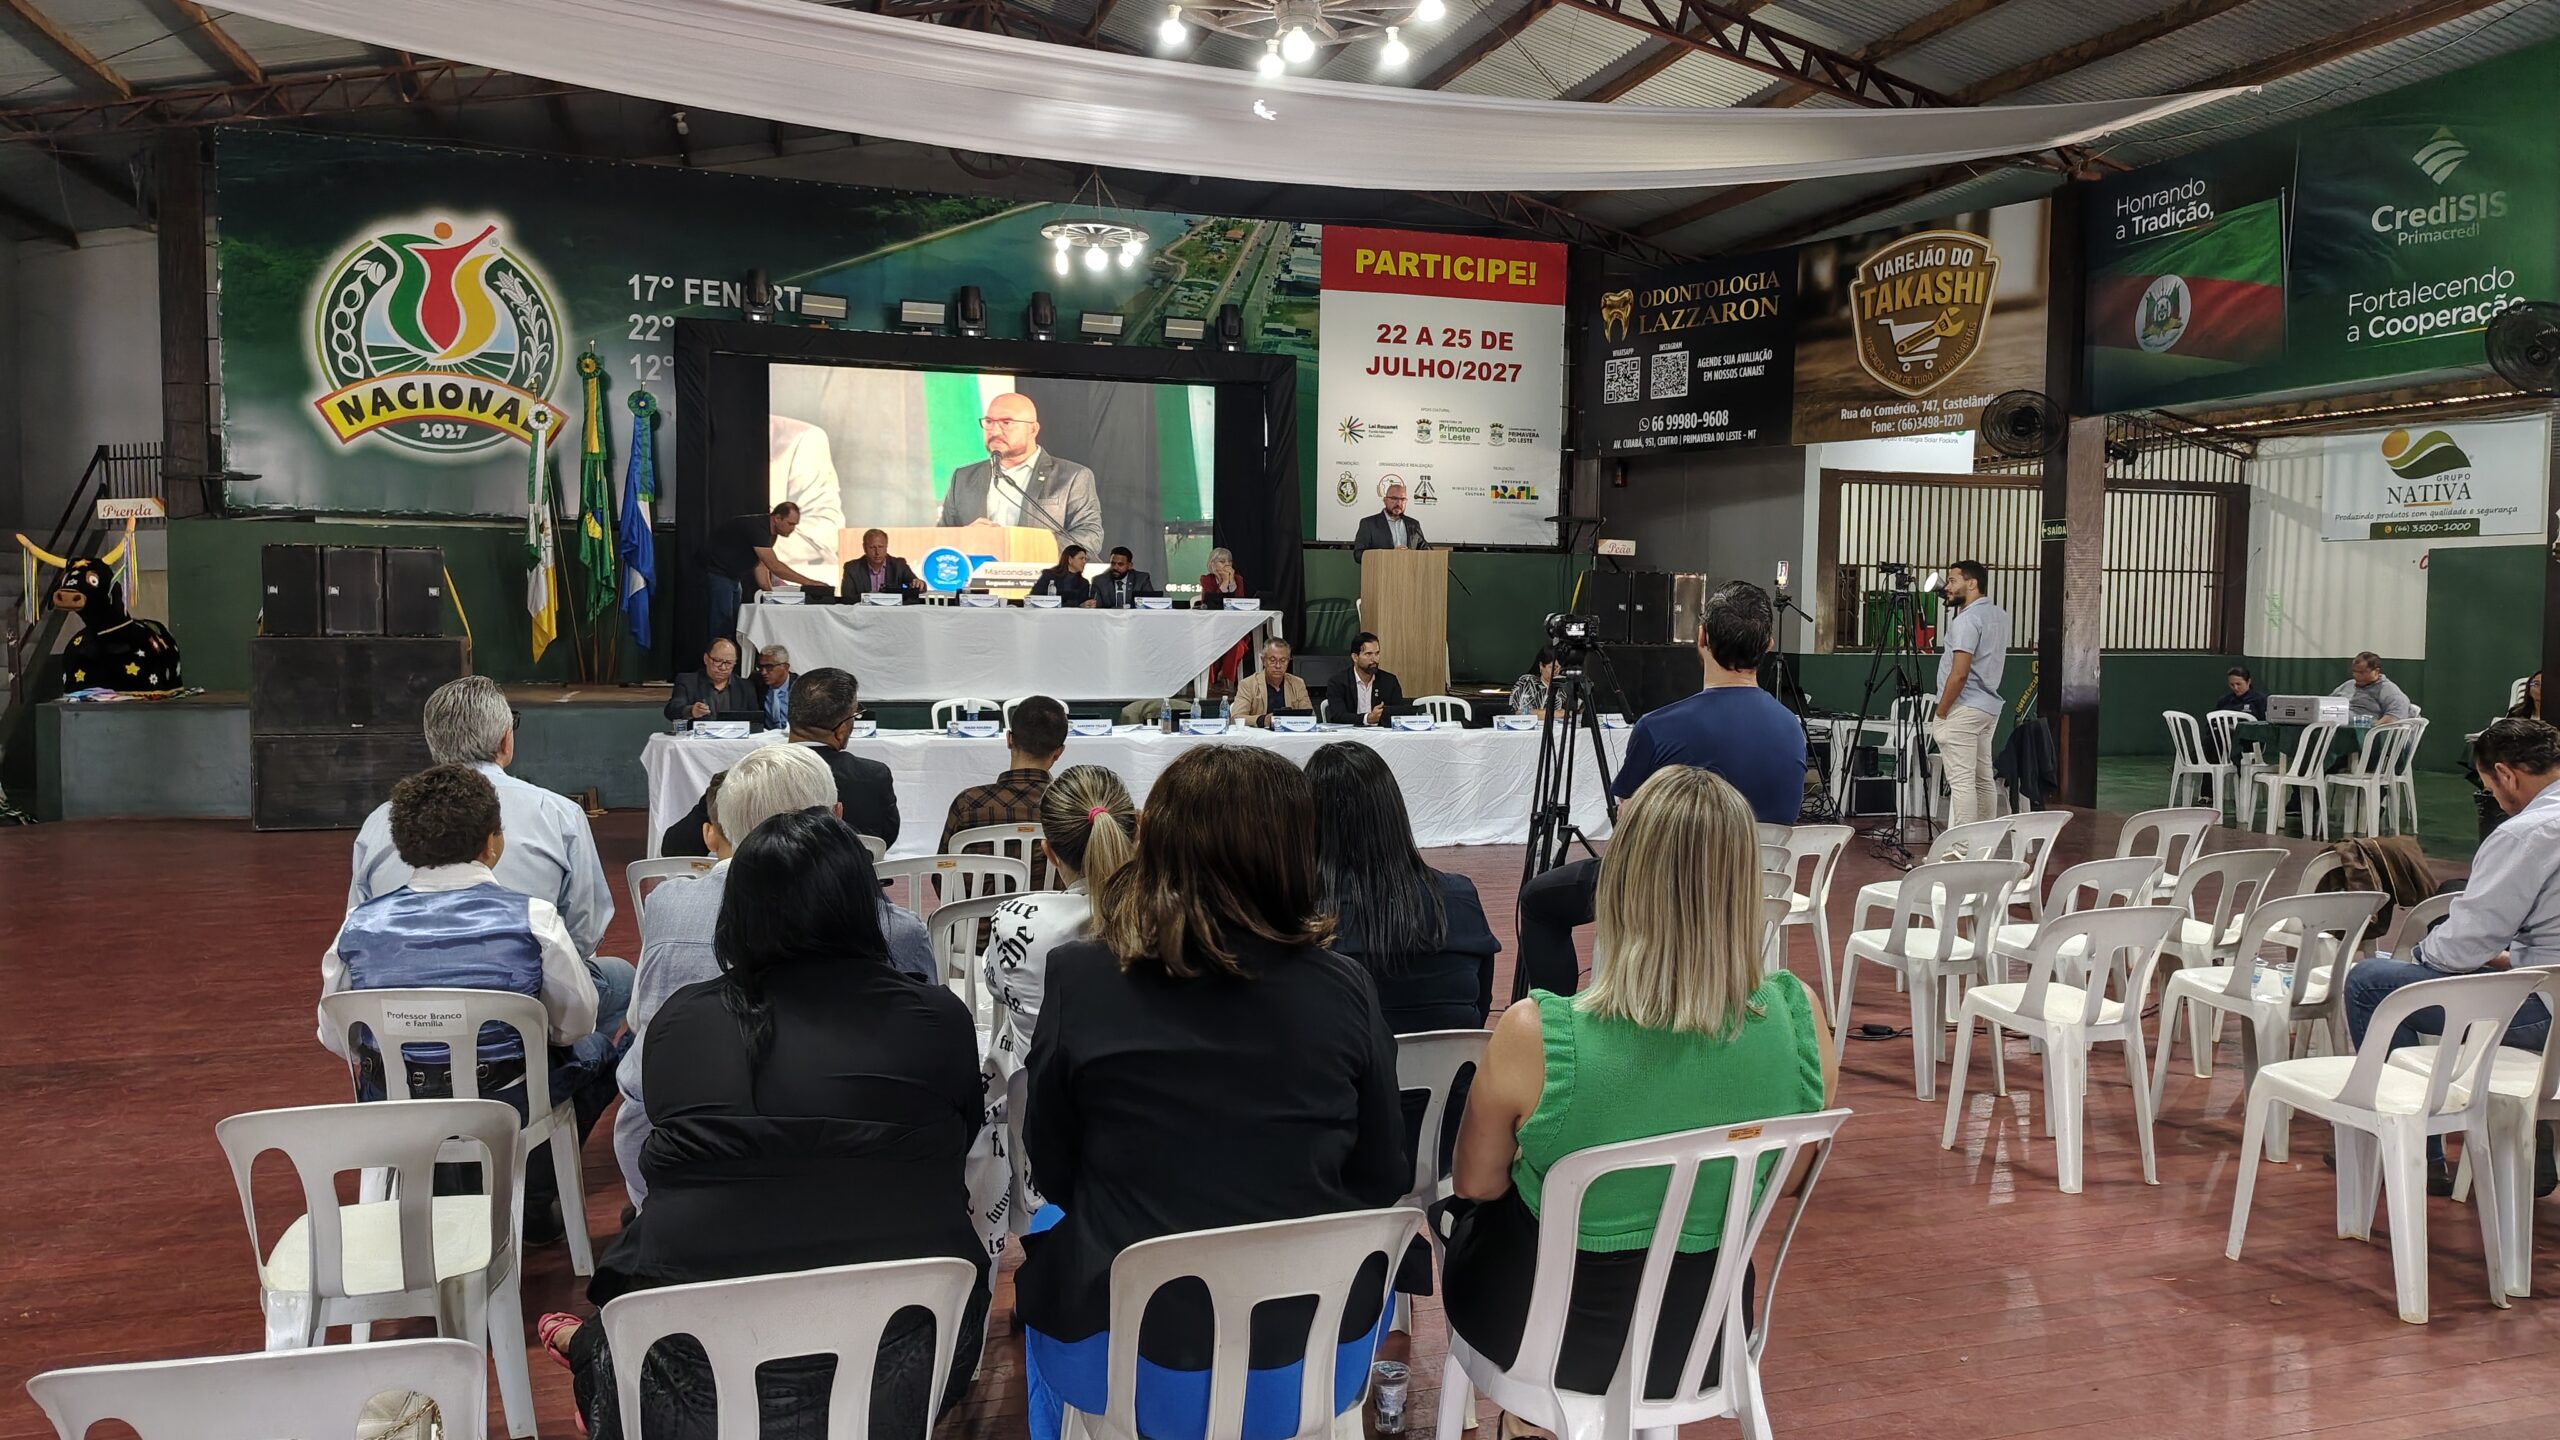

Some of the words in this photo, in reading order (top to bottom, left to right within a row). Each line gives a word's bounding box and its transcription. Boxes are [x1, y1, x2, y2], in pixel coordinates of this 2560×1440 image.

[2117, 177, 2206, 217] Honrando
[2115, 224, 2126, 240] a
[2131, 200, 2214, 235] Tradição,
[2371, 190, 2507, 232] CrediSIS
[1355, 248, 1537, 286] PARTICIPE!
[1873, 243, 1946, 282] VAREJÃO
[1950, 247, 1973, 267] DO
[684, 277, 802, 312] FENRT
[1639, 270, 1781, 308] ODONTOLOGIA
[1859, 270, 1985, 321] TAKASHI
[2348, 266, 2515, 316] Fortalecendo
[1639, 295, 1781, 335] LAZZARON
[1376, 323, 1407, 344] 22
[1416, 326, 1434, 346] A
[1441, 328, 1472, 348] 25
[1481, 331, 1514, 351] DE
[2347, 325, 2360, 342] a
[1659, 341, 1683, 351] INSTAGRAM
[1864, 336, 1885, 372] MERCADO
[1697, 356, 1722, 369] AGENDE
[1722, 355, 1736, 366] SUA
[1736, 348, 1773, 362] AVALIAÇÃO
[1365, 355, 1523, 384] JULHO/2027
[1703, 370, 1713, 382] EM
[1713, 368, 1738, 381] NOSSOS
[1738, 364, 1765, 378] CANAIS!
[1840, 408, 1858, 420] Rua
[1860, 406, 1872, 418] do
[1874, 402, 1920, 417] Comércio,
[1922, 399, 1940, 414] 747,
[1439, 424, 1480, 434] Primavera
[1651, 415, 1664, 431] 66
[1666, 409, 1729, 431] 99980-9608
[1871, 421, 1895, 433] Fone:
[1897, 413, 1964, 432] (66)3498-1270
[419, 422, 469, 440] 2027
[1448, 433, 1471, 441] Leste
[1613, 439, 1622, 449] AV.
[1623, 437, 1645, 449] CUIABÁ,
[1657, 435, 1678, 446] CENTRO
[1683, 433, 1715, 444] PRIMAVERA
[1716, 431, 1725, 442] DO
[1726, 430, 1742, 441] LESTE
[1748, 429, 1757, 440] MT
[2436, 473, 2471, 482] GRUPO
[1490, 485, 1539, 500] BRASIL
[2386, 482, 2472, 504] NATIVA
[102, 504, 153, 518] Prenda
[2335, 511, 2374, 521] Produzindo
[2376, 510, 2410, 520] produtos
[2411, 509, 2428, 518] com
[2429, 507, 2467, 519] qualidade
[2476, 505, 2518, 517] segurança
[2046, 523, 2067, 536] SAÍDA
[2394, 524, 2410, 533] (66)
[2412, 522, 2471, 533] 3500-1000
[1607, 542, 1632, 554] Peão
[984, 568, 1032, 576] Marcondes
[386, 1011, 428, 1020] Professor
[430, 1012, 462, 1020] Branco
